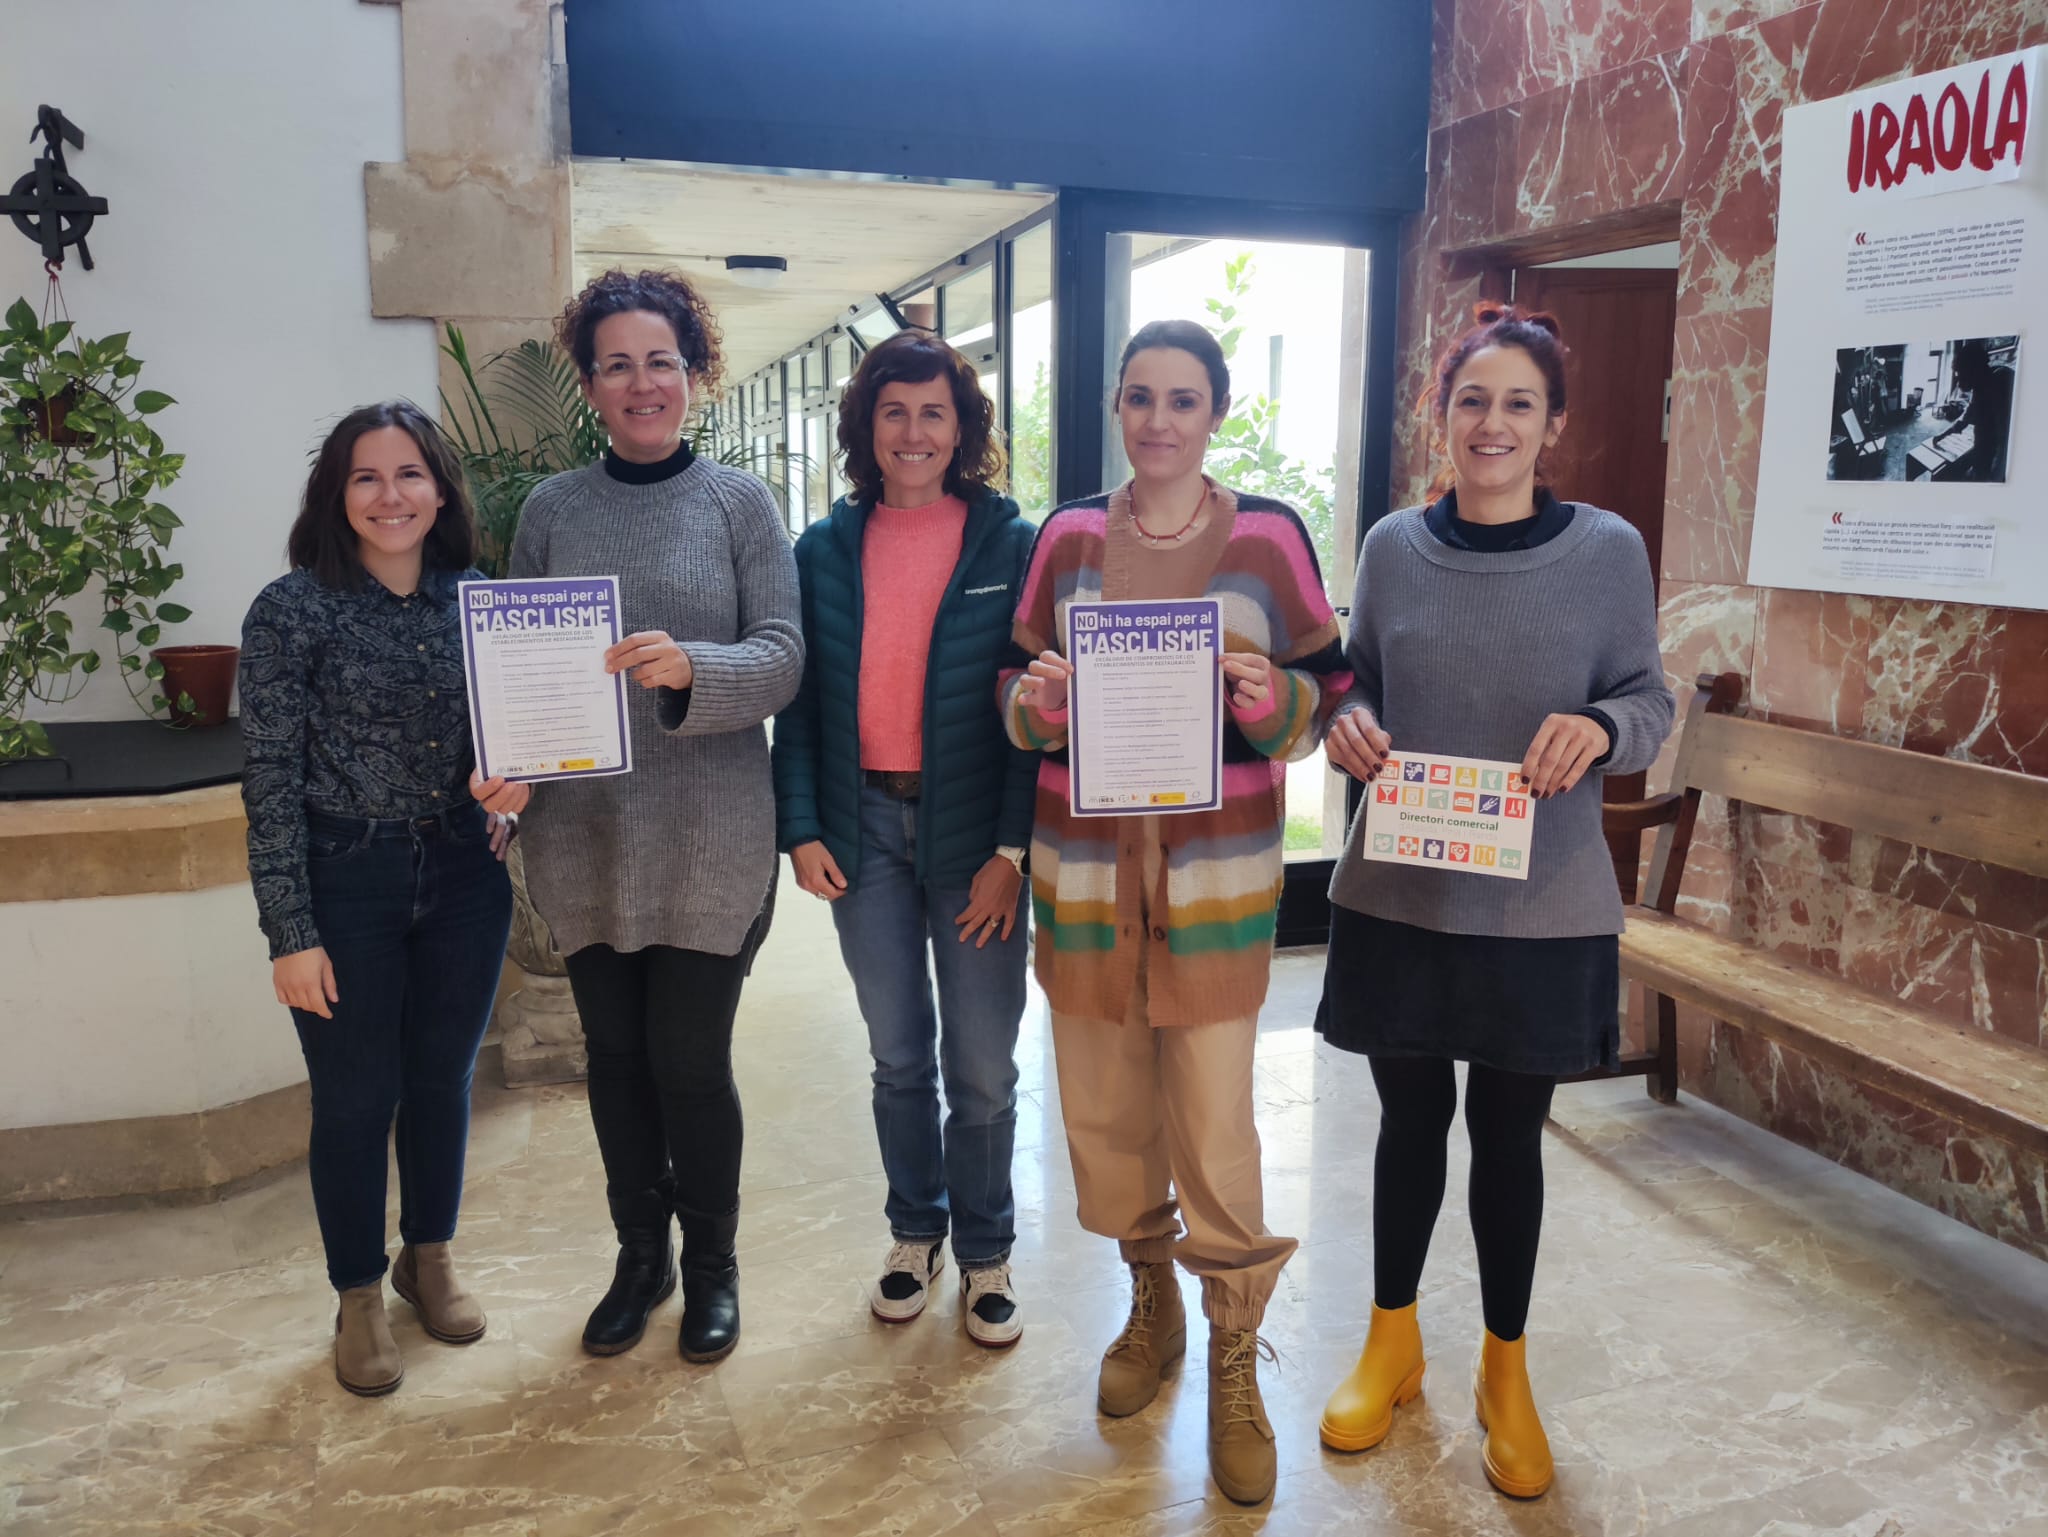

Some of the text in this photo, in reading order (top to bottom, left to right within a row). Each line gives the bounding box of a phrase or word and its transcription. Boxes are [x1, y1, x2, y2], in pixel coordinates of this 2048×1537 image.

[1847, 60, 2028, 193] IRAOLA
[472, 588, 608, 606] NO hi ha espai per al
[470, 605, 611, 632] MASCLISME
[1077, 611, 1212, 629] NO hi ha espai per al
[1075, 629, 1214, 655] MASCLISME
[1399, 811, 1499, 832] Directori comercial
